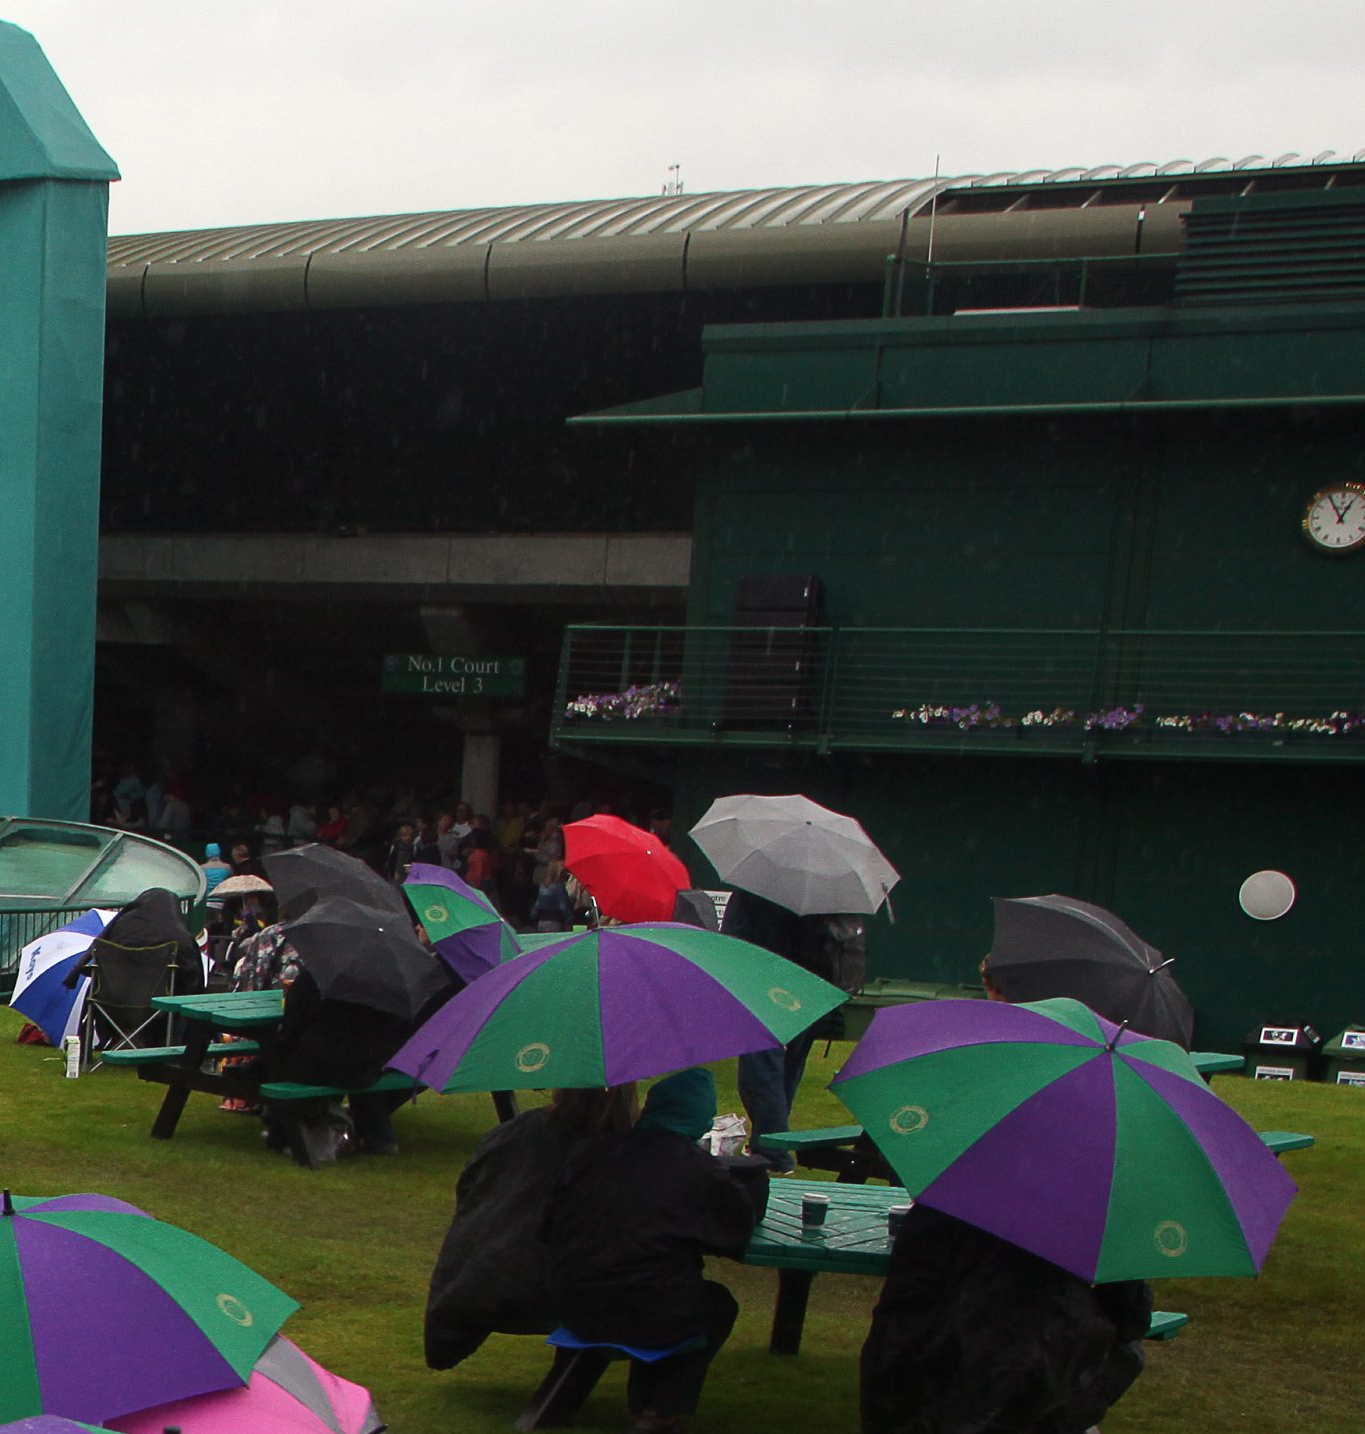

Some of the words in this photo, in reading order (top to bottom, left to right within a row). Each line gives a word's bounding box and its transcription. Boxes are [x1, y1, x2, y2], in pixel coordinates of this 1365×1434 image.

[408, 655, 443, 672] No.1
[450, 656, 499, 674] Court
[422, 675, 465, 693] Level
[473, 677, 483, 694] 3
